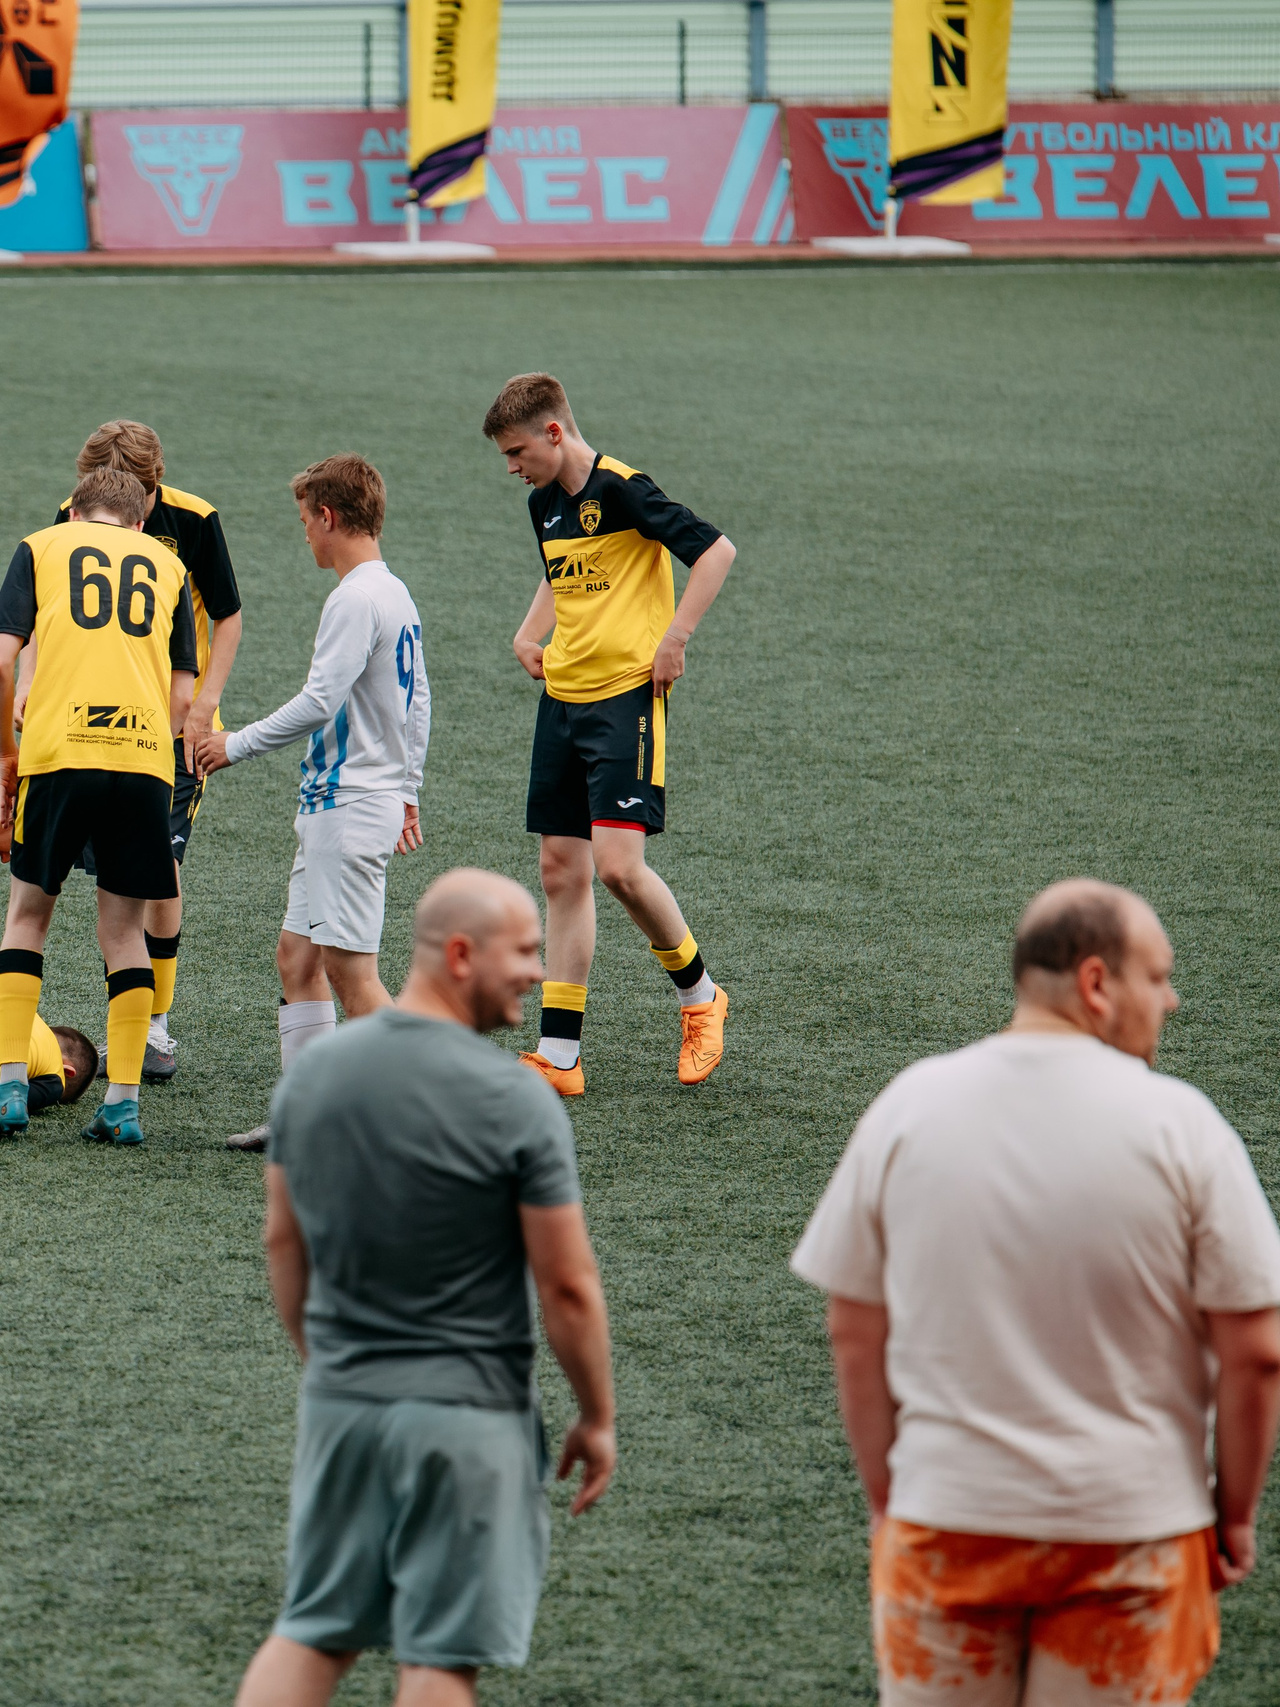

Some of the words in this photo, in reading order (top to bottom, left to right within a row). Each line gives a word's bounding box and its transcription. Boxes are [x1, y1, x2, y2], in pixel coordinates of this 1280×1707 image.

[972, 153, 1280, 220] ВЕЛЕ
[68, 545, 158, 638] 66
[586, 581, 610, 593] RUS
[136, 739, 158, 751] RUS
